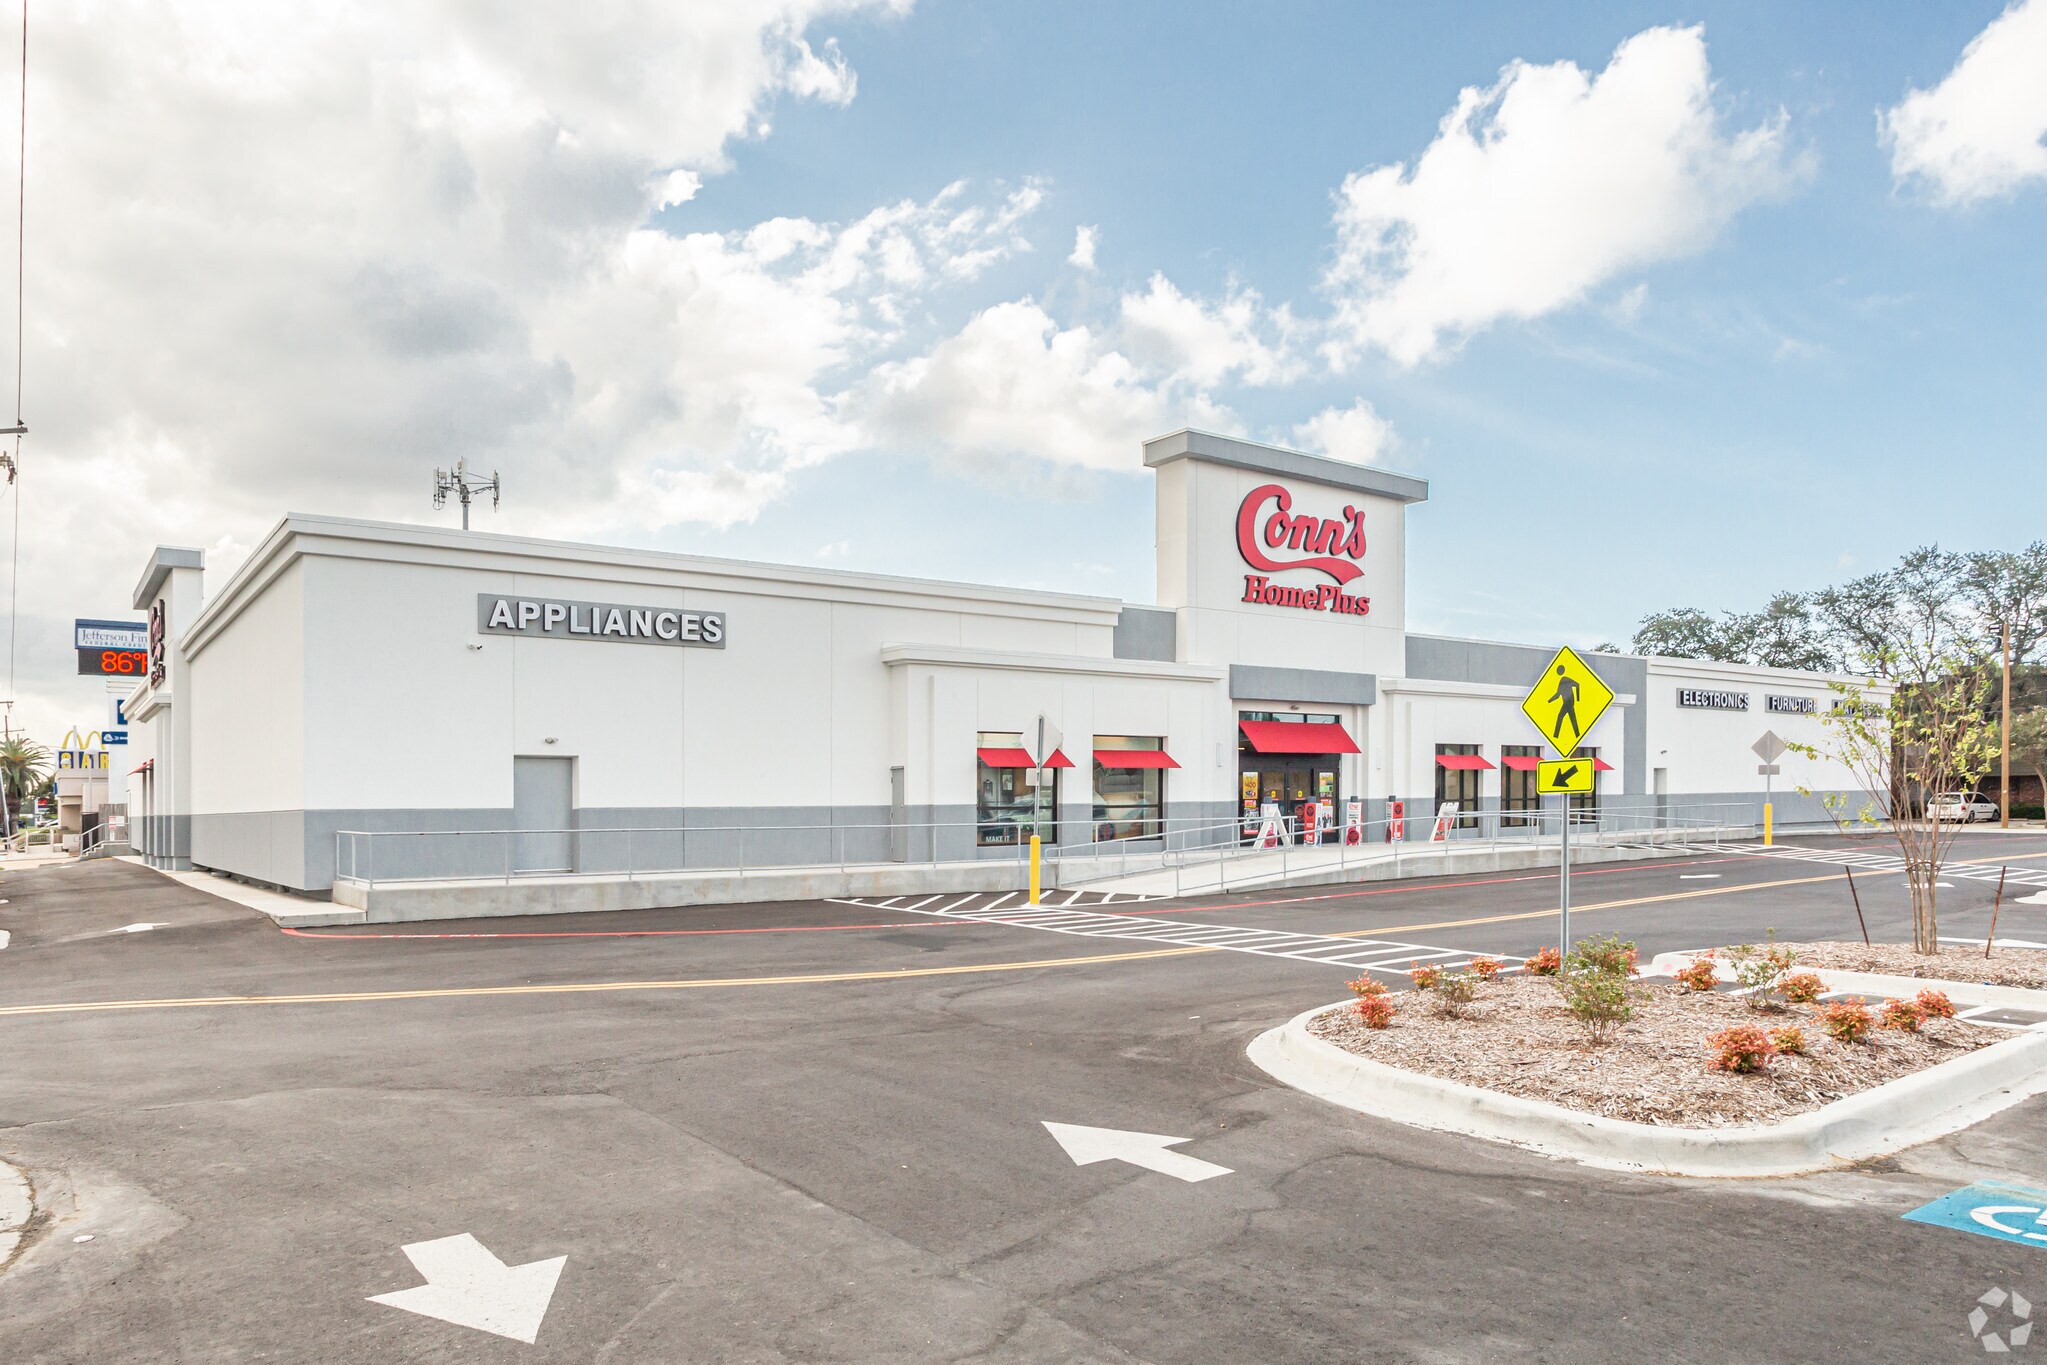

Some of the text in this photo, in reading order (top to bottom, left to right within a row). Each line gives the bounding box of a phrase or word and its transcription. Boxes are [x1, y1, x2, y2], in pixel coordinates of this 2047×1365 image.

[1236, 484, 1367, 586] Conn's
[1241, 574, 1370, 616] HomePlus
[82, 629, 128, 642] Jefferson
[486, 598, 723, 643] APPLIANCES
[1683, 690, 1749, 709] ELECTRONICS
[985, 835, 1003, 843] MAKE
